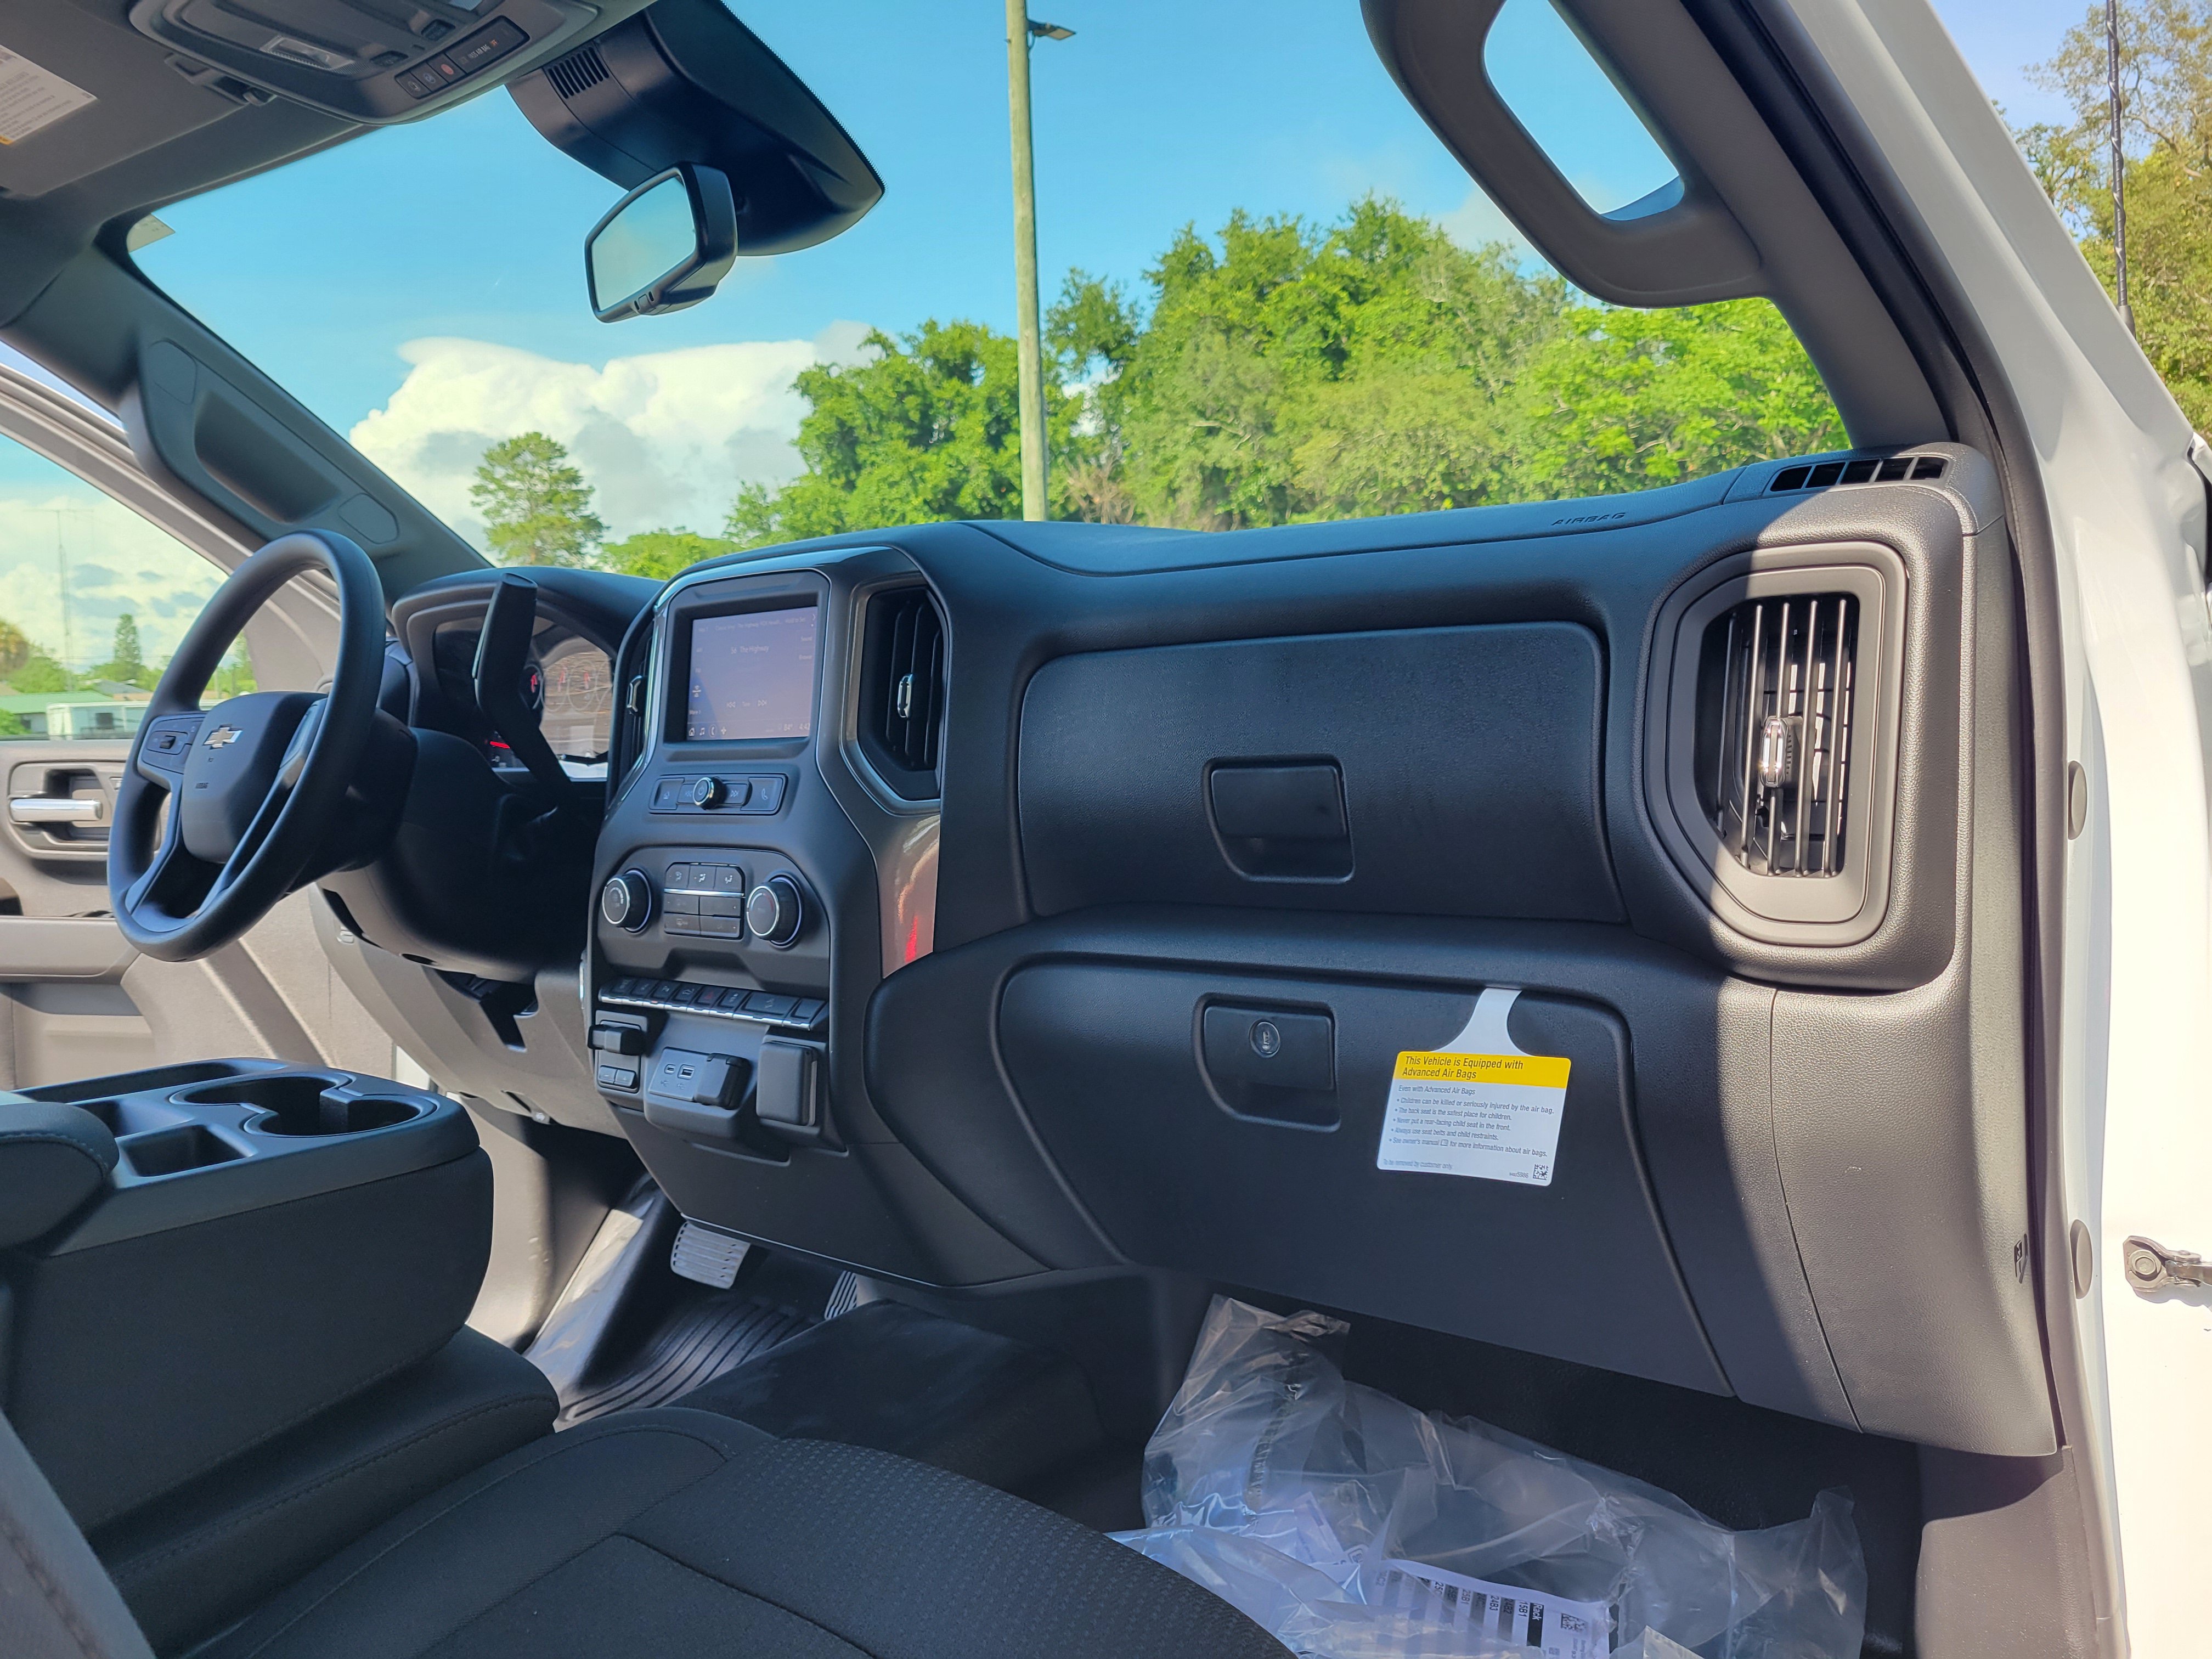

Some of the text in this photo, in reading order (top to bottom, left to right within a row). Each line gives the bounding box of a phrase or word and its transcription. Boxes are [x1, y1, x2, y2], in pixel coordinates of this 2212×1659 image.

[1551, 512, 1626, 526] AIRBAG
[749, 645, 769, 653] Highway
[1406, 1056, 1523, 1069] This Vehicle is Equipped with
[1402, 1068, 1477, 1080] Advanced Air Bags
[1463, 1101, 1488, 1109] seriously
[1489, 1102, 1510, 1110] injured
[1541, 1106, 1555, 1115] bag.
[1472, 1142, 1504, 1152] information
[1532, 1149, 1548, 1158] bags.
[1460, 1589, 1471, 1605] 25B1
[1489, 1595, 1500, 1612] 24B3
[1504, 1599, 1514, 1615] 24B2
[1518, 1601, 1528, 1618] 15B1
[1532, 1603, 1543, 1621] Rack
